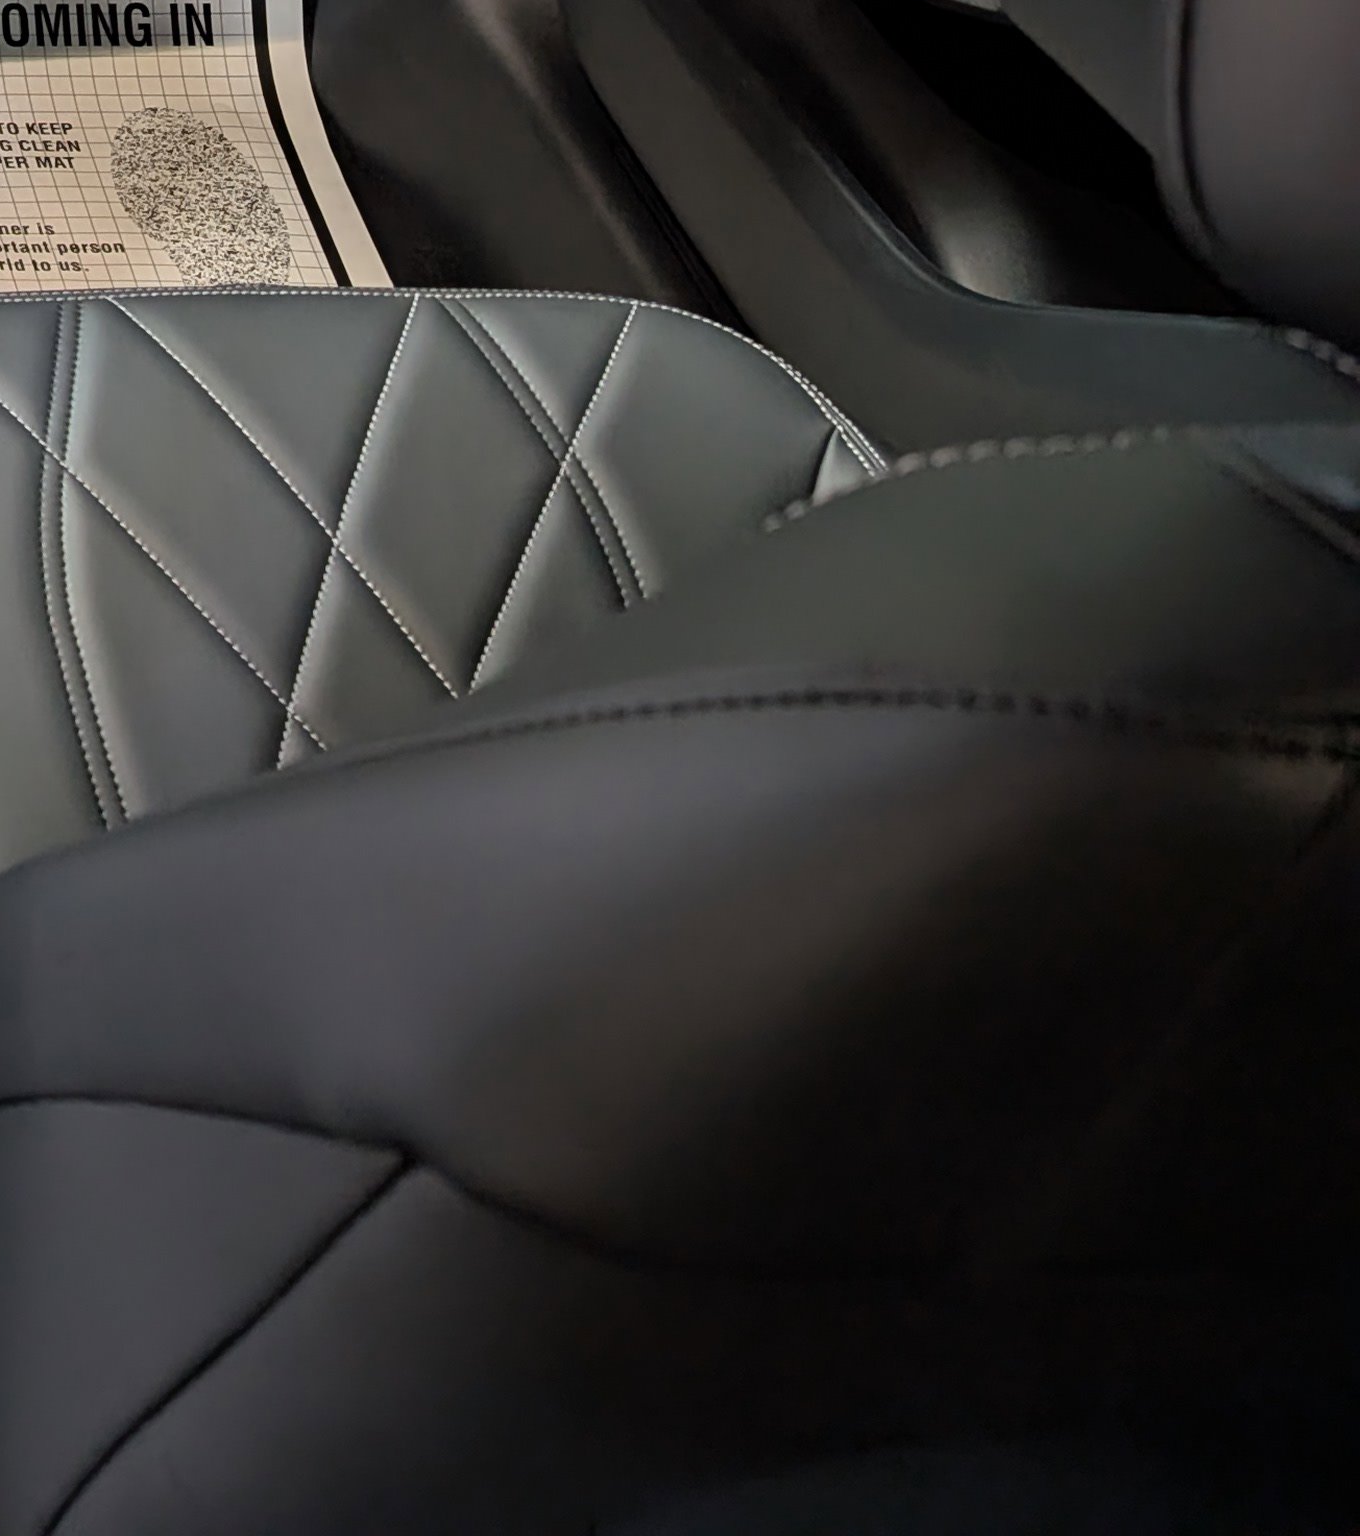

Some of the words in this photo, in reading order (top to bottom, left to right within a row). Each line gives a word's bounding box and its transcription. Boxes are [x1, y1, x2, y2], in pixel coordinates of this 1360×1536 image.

[169, 3, 214, 47] IN
[26, 122, 74, 135] KEEP
[19, 139, 82, 152] CLEAN
[35, 156, 75, 169] MAT
[37, 221, 55, 235] is
[56, 242, 126, 256] person
[32, 258, 51, 272] to
[59, 260, 90, 272] us.
